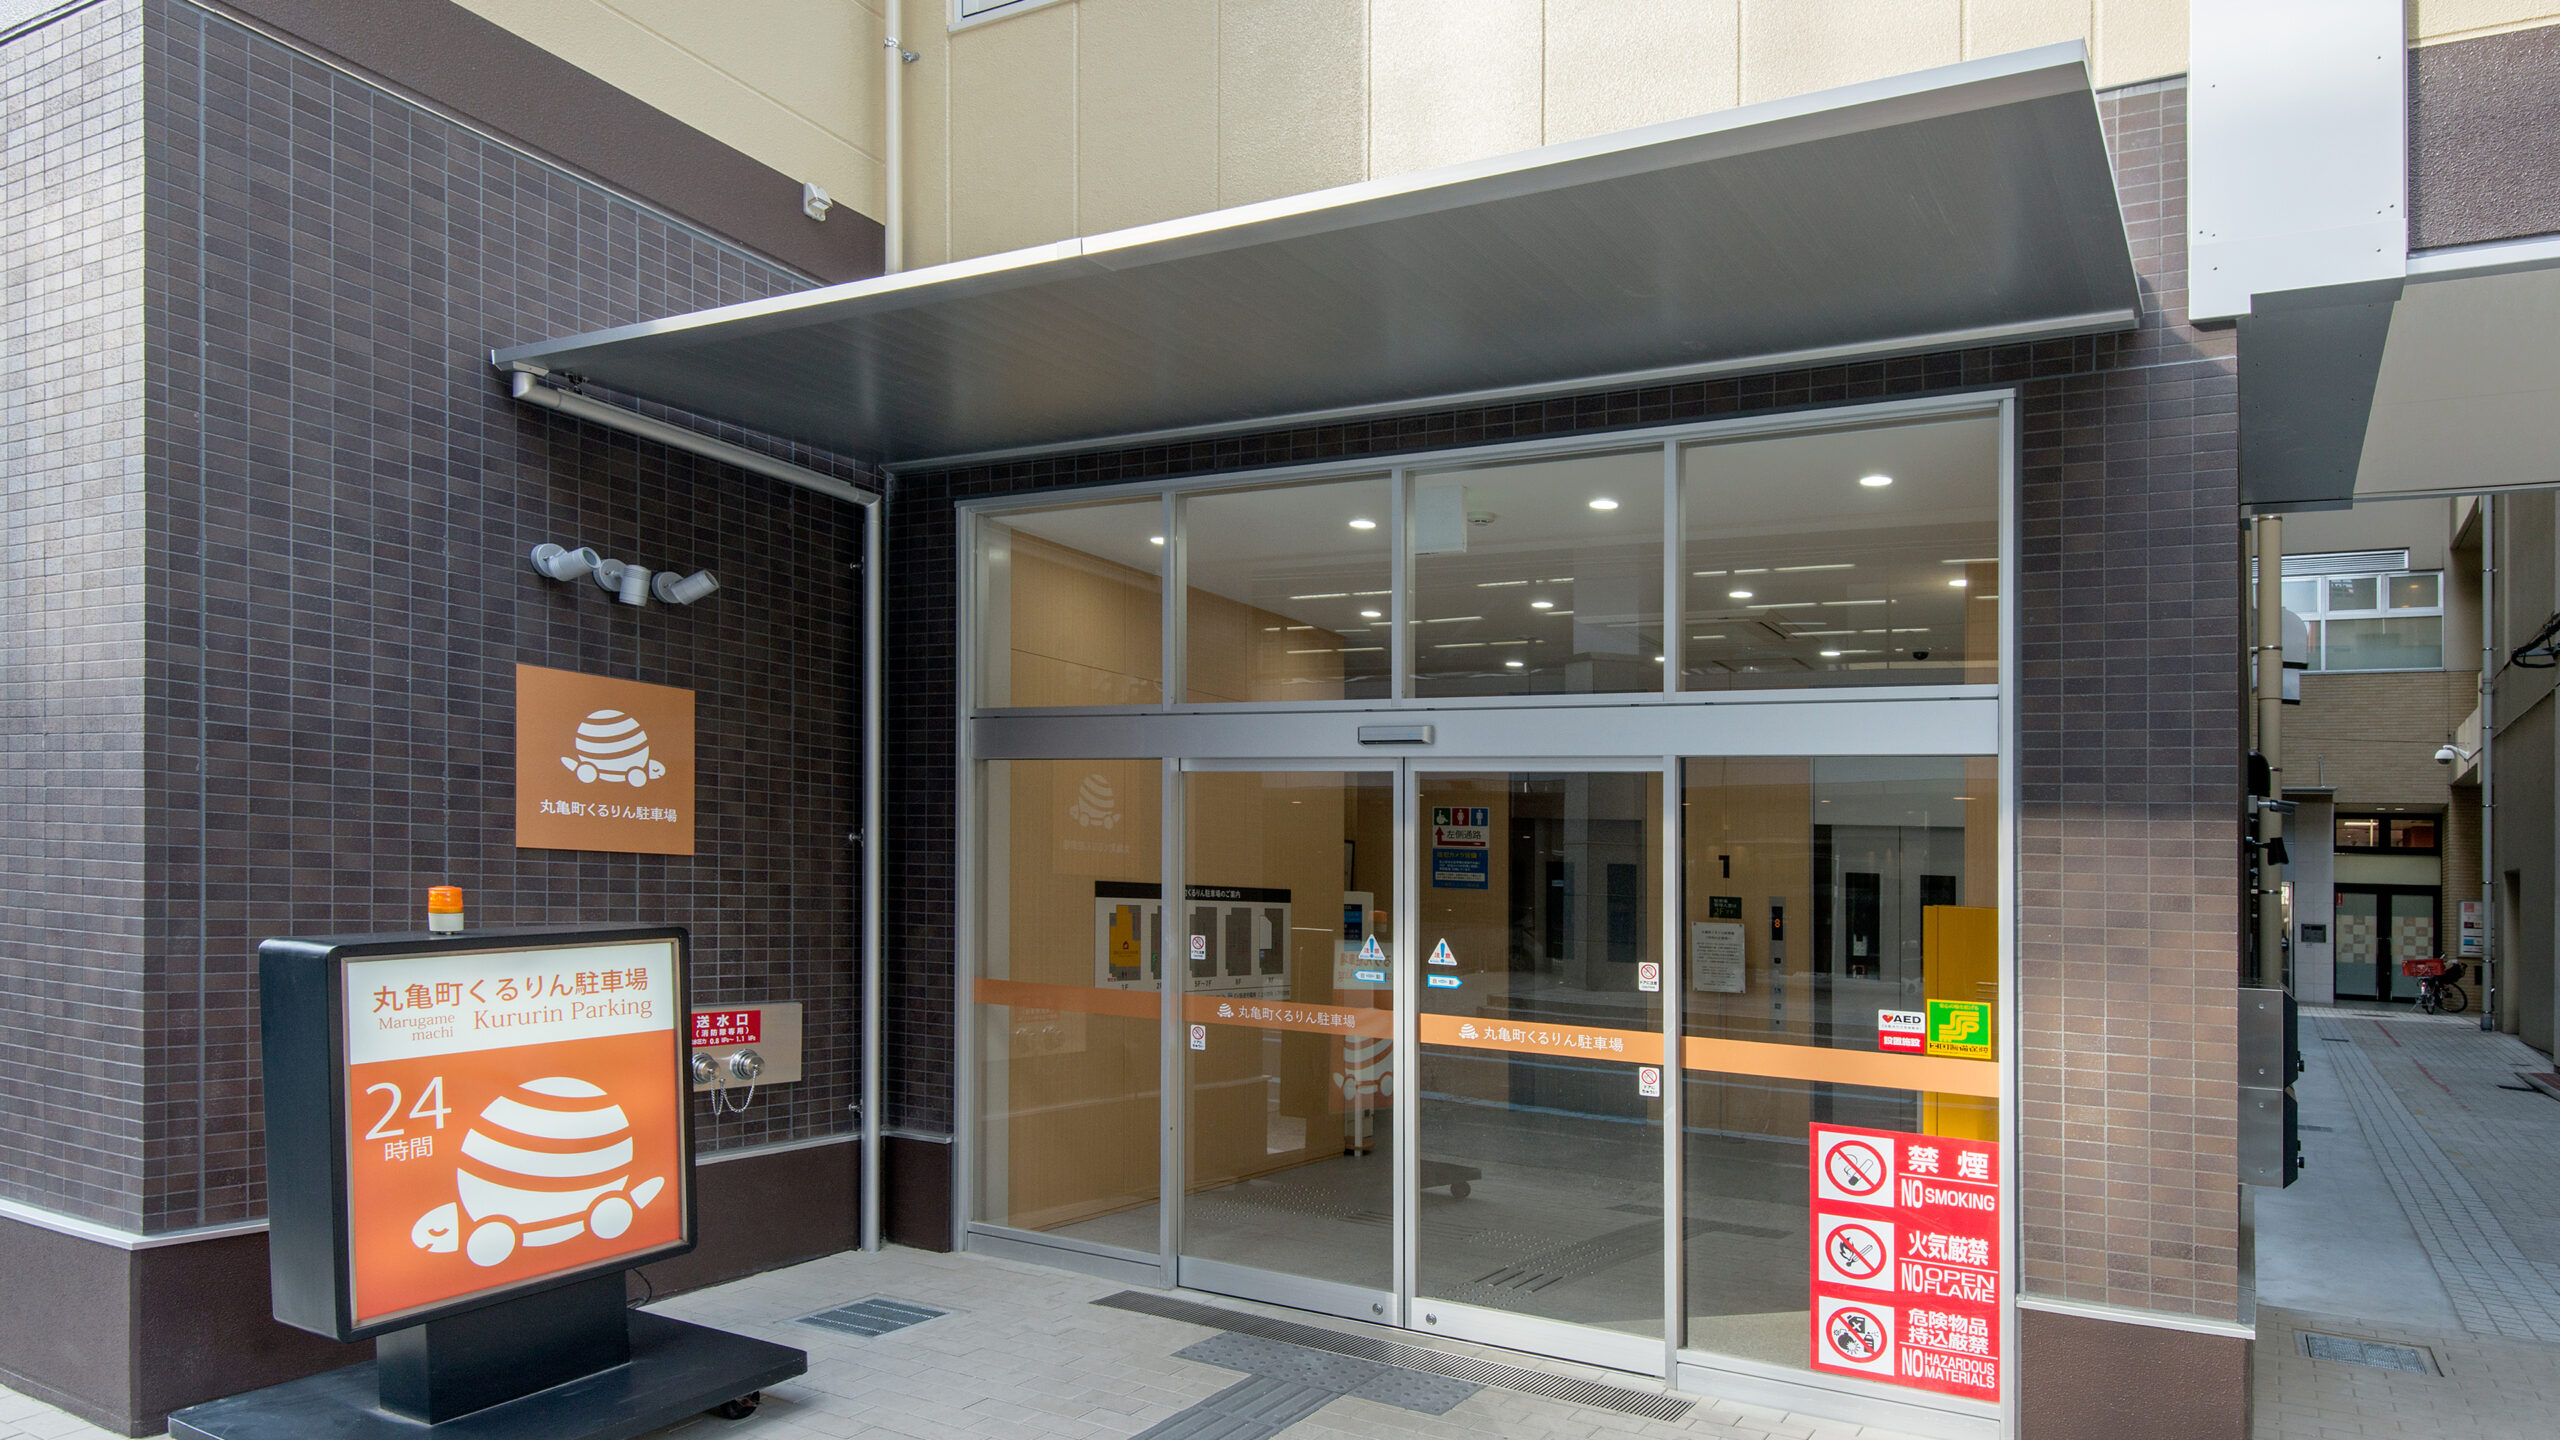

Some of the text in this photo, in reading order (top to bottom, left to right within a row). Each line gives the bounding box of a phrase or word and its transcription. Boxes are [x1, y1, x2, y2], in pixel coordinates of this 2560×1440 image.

[539, 799, 678, 822] 丸亀町くるりん駐車場
[1718, 855, 1730, 879] 1
[372, 967, 649, 1014] 丸亀町くるりん駐車場
[378, 1013, 455, 1030] Marugame
[473, 999, 653, 1030] Kururin Parking
[696, 1013, 749, 1028] 送水口
[1238, 1005, 1356, 1028] 丸亀町くるりん駐車場
[1893, 1015, 1921, 1024] AED
[412, 1026, 454, 1041] machi
[1483, 1026, 1624, 1053] 丸亀町くるりん駐車場
[365, 1076, 452, 1140] 24
[384, 1135, 433, 1162] 時間
[1908, 1145, 1989, 1180] 禁煙
[1901, 1178, 1995, 1211] NO SMOKING
[1908, 1230, 1989, 1266] 火気厳禁
[1901, 1262, 1995, 1293] NO OPEN
[1924, 1280, 1995, 1304] FLAME
[1908, 1308, 1989, 1337] 危険物品
[1908, 1326, 1989, 1355] 持込厳禁
[1901, 1347, 1995, 1378] NO HAZARDOUS
[1924, 1365, 1995, 1389] MATERIALS
